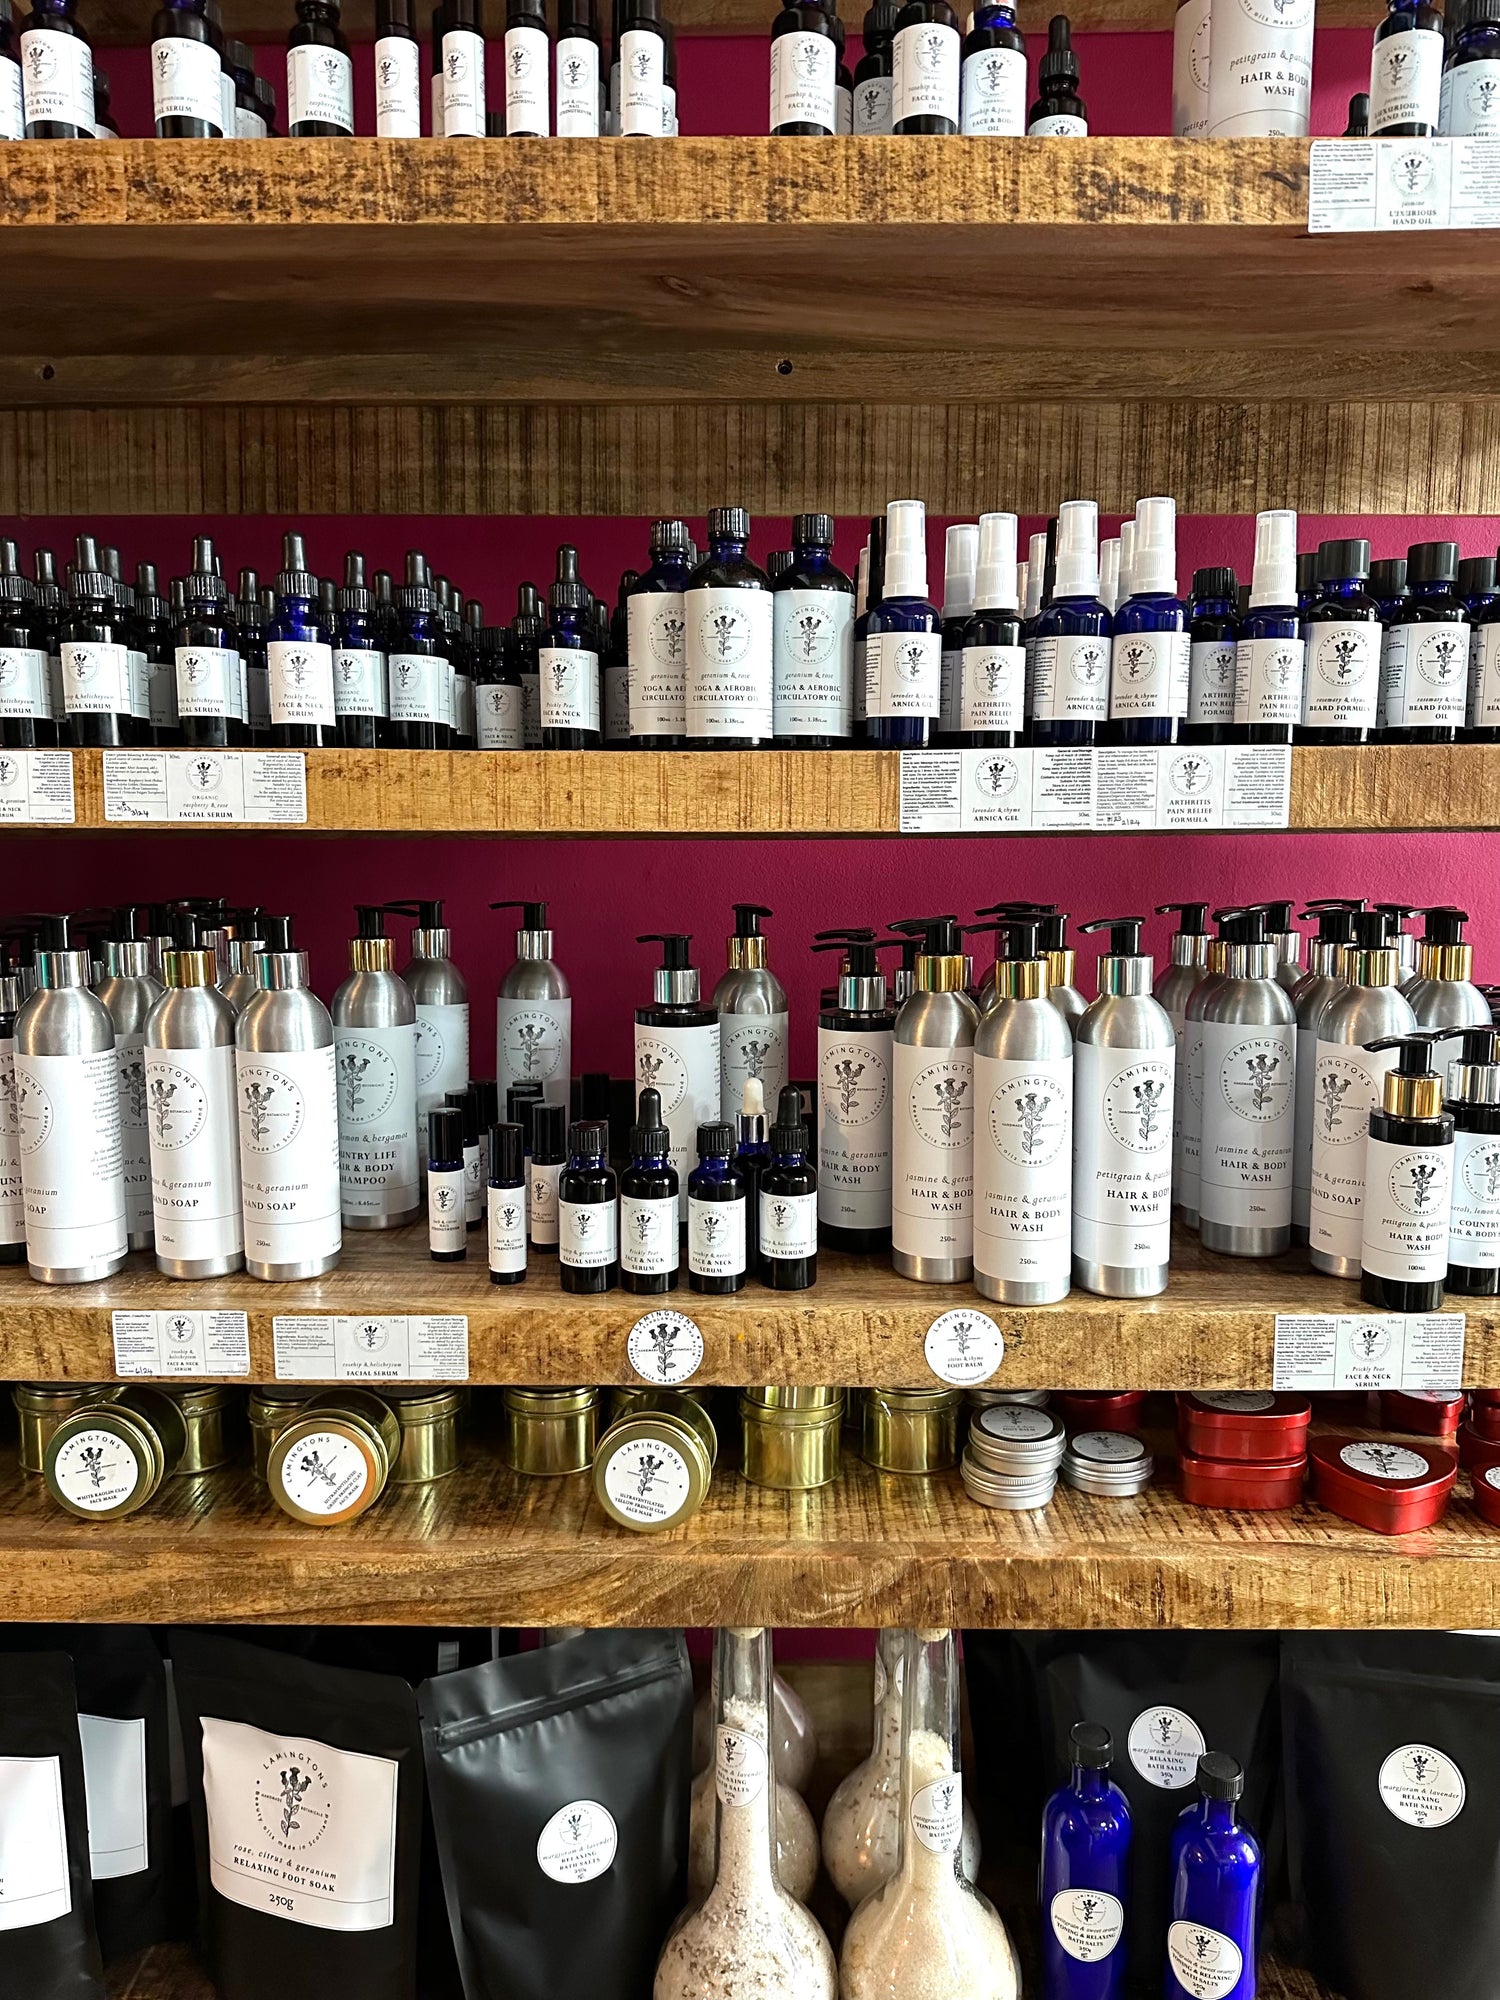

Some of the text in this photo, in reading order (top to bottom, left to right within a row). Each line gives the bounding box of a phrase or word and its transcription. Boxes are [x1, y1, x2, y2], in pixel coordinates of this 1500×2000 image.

[1230, 50, 1288, 70] petitgrain &
[1240, 71, 1309, 88] HAIR & BODY
[1263, 85, 1295, 97] WASH
[1389, 209, 1437, 217] LUXURIOUS
[785, 672, 813, 681] geranium
[815, 672, 822, 680] &
[194, 705, 220, 714] SERUM
[1333, 712, 1348, 720] OIL
[1435, 712, 1448, 720] OIL
[374, 1150, 397, 1160] LIFE
[850, 1150, 889, 1161] geranium
[821, 1161, 840, 1171] HAIR
[852, 1164, 880, 1173] BODY
[1221, 1160, 1287, 1170] HAIR & BODY
[833, 1174, 862, 1185] WASH
[905, 1172, 950, 1185] jasmine &
[1095, 1170, 1152, 1184] petitgrain &
[1241, 1173, 1272, 1183] WASH
[168, 1179, 212, 1190] geranium
[263, 1182, 309, 1194] geranium
[911, 1188, 974, 1199] HAIR & BOD
[984, 1191, 1018, 1204] jasmine
[1021, 1193, 1030, 1204] &
[1106, 1188, 1138, 1200] HAIR
[1141, 1189, 1149, 1199] &
[171, 1198, 199, 1208] SOAP
[1332, 1193, 1361, 1206] SOAP
[266, 1201, 296, 1211] SOAP
[931, 1202, 962, 1212] WASH
[1130, 1203, 1159, 1213] WASH
[990, 1207, 1062, 1219] HAIR & BODY
[1010, 1222, 1044, 1233] WASH
[1389, 1232, 1444, 1241] HAIR & BODY
[1406, 1244, 1431, 1252] WASH
[633, 1310, 697, 1331] LAMINGTONS
[933, 1313, 992, 1332] LAMINGTONS
[61, 1435, 121, 1462] LAMINGTONS
[286, 1436, 331, 1484] LAMINGTONS
[620, 1443, 682, 1471] LAMINGTONS
[77, 1495, 94, 1503] WHITE
[114, 1487, 128, 1495] CLAY
[103, 1495, 118, 1503] MASK
[638, 1509, 653, 1518] MASK
[654, 1508, 667, 1516] CLAY
[1149, 1756, 1184, 1764] RELAXING
[263, 1751, 329, 1790] LAMINGTONS
[1147, 1762, 1164, 1770] BATH
[1402, 1793, 1440, 1804] RELAXING
[1429, 1788, 1459, 1799] lavender
[1399, 1801, 1443, 1812] BATH SALTS
[277, 1840, 296, 1851] made
[308, 1813, 330, 1847] Scotland
[561, 1851, 598, 1863] RELAXING
[258, 1848, 284, 1864] citrus
[286, 1858, 293, 1867] &
[295, 1861, 337, 1880] geranium
[559, 1857, 601, 1871] BATH SALTS
[233, 1856, 336, 1893] RELAXING FOOT SOAK
[269, 1893, 294, 1911] 250g
[1056, 1922, 1080, 1936] TONING
[1086, 1932, 1116, 1941] RELAXING
[1068, 1935, 1084, 1944] BATH
